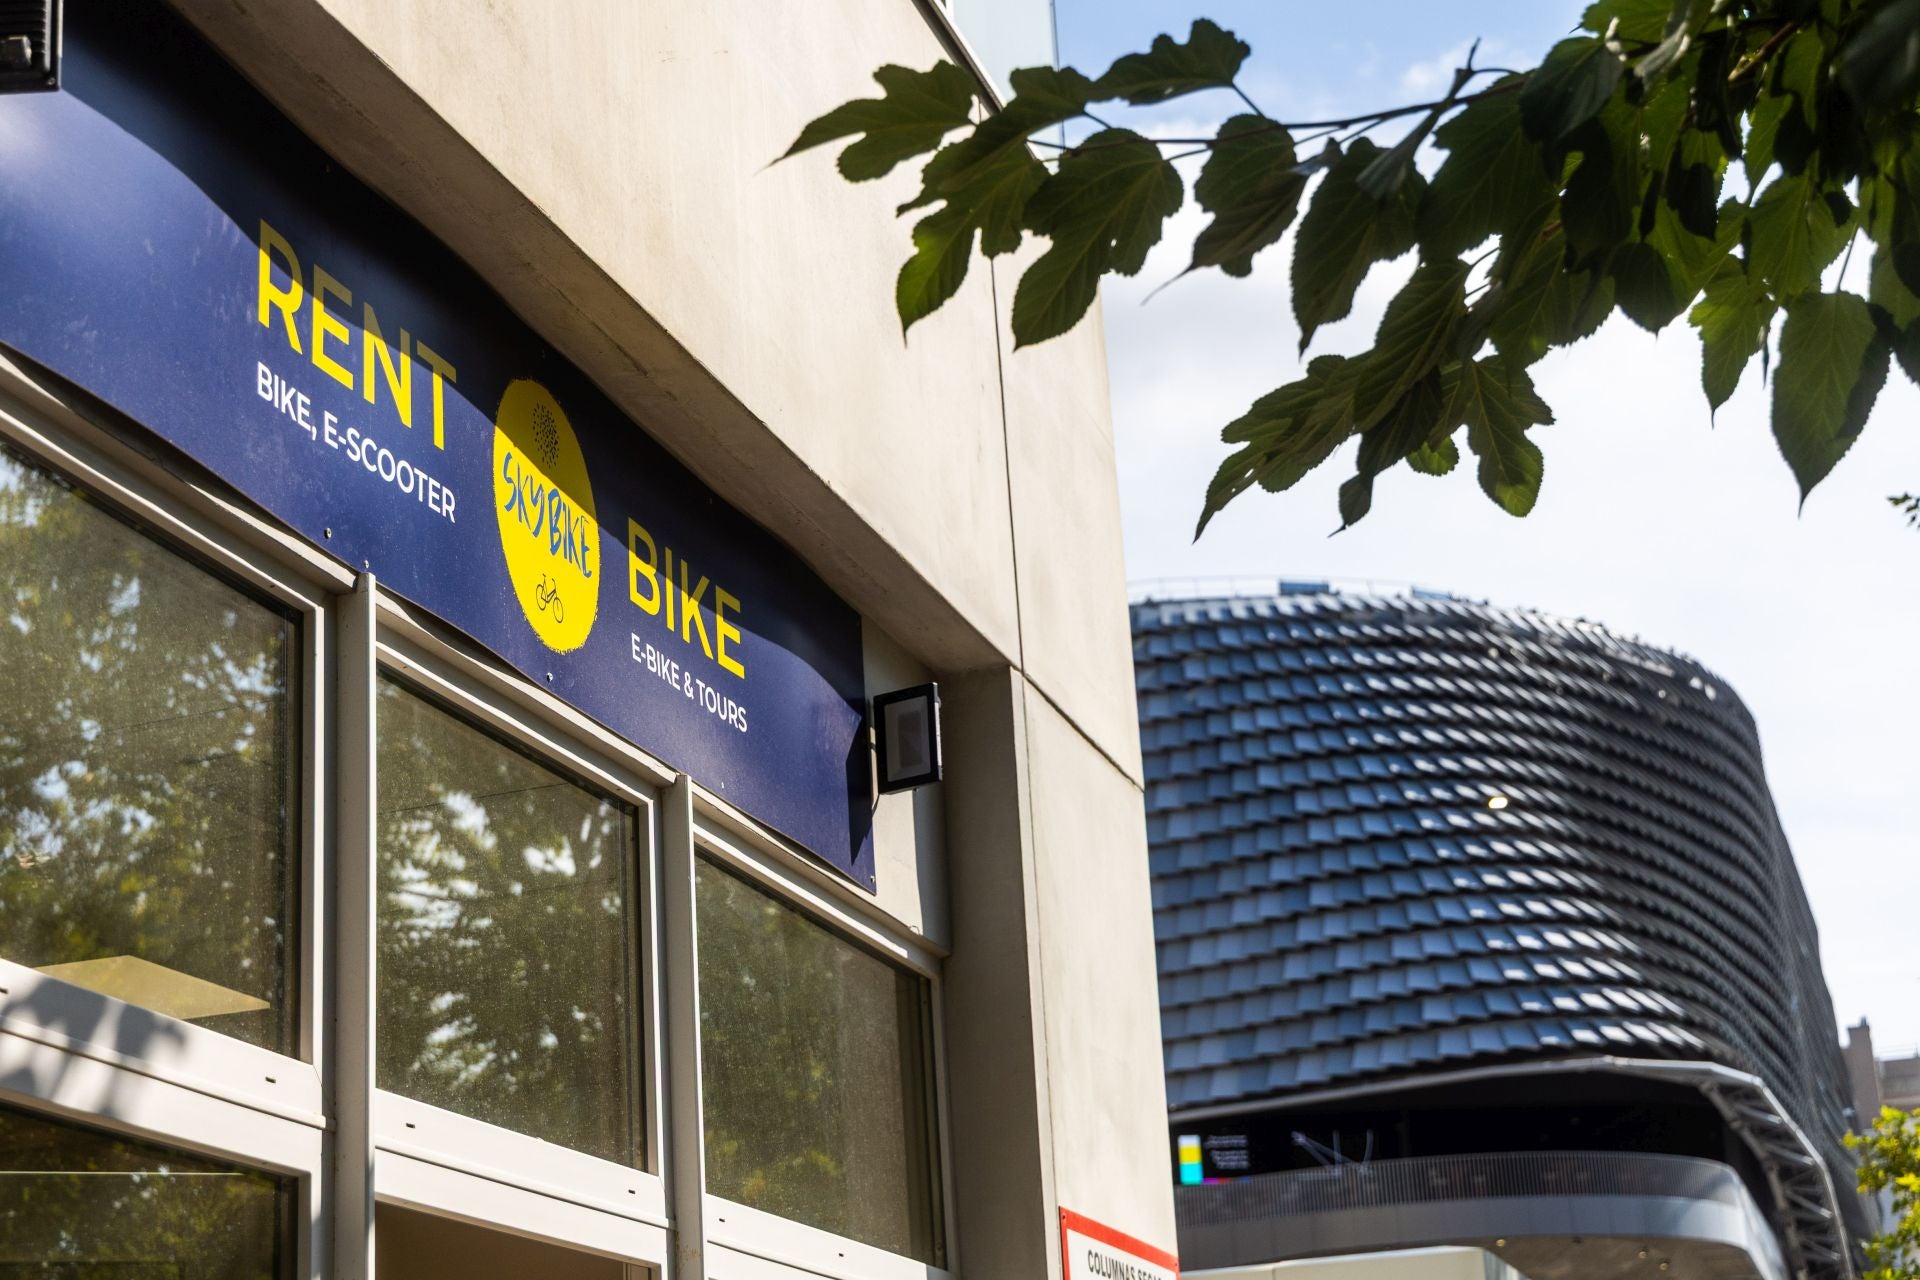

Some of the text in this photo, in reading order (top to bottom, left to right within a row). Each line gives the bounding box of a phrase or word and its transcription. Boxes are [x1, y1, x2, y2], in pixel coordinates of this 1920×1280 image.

[258, 218, 457, 451] RENT
[257, 361, 456, 523] BIKE, E-SCOOTER
[628, 517, 745, 679] BIKE
[631, 632, 748, 733] E-BIKE & TOURS
